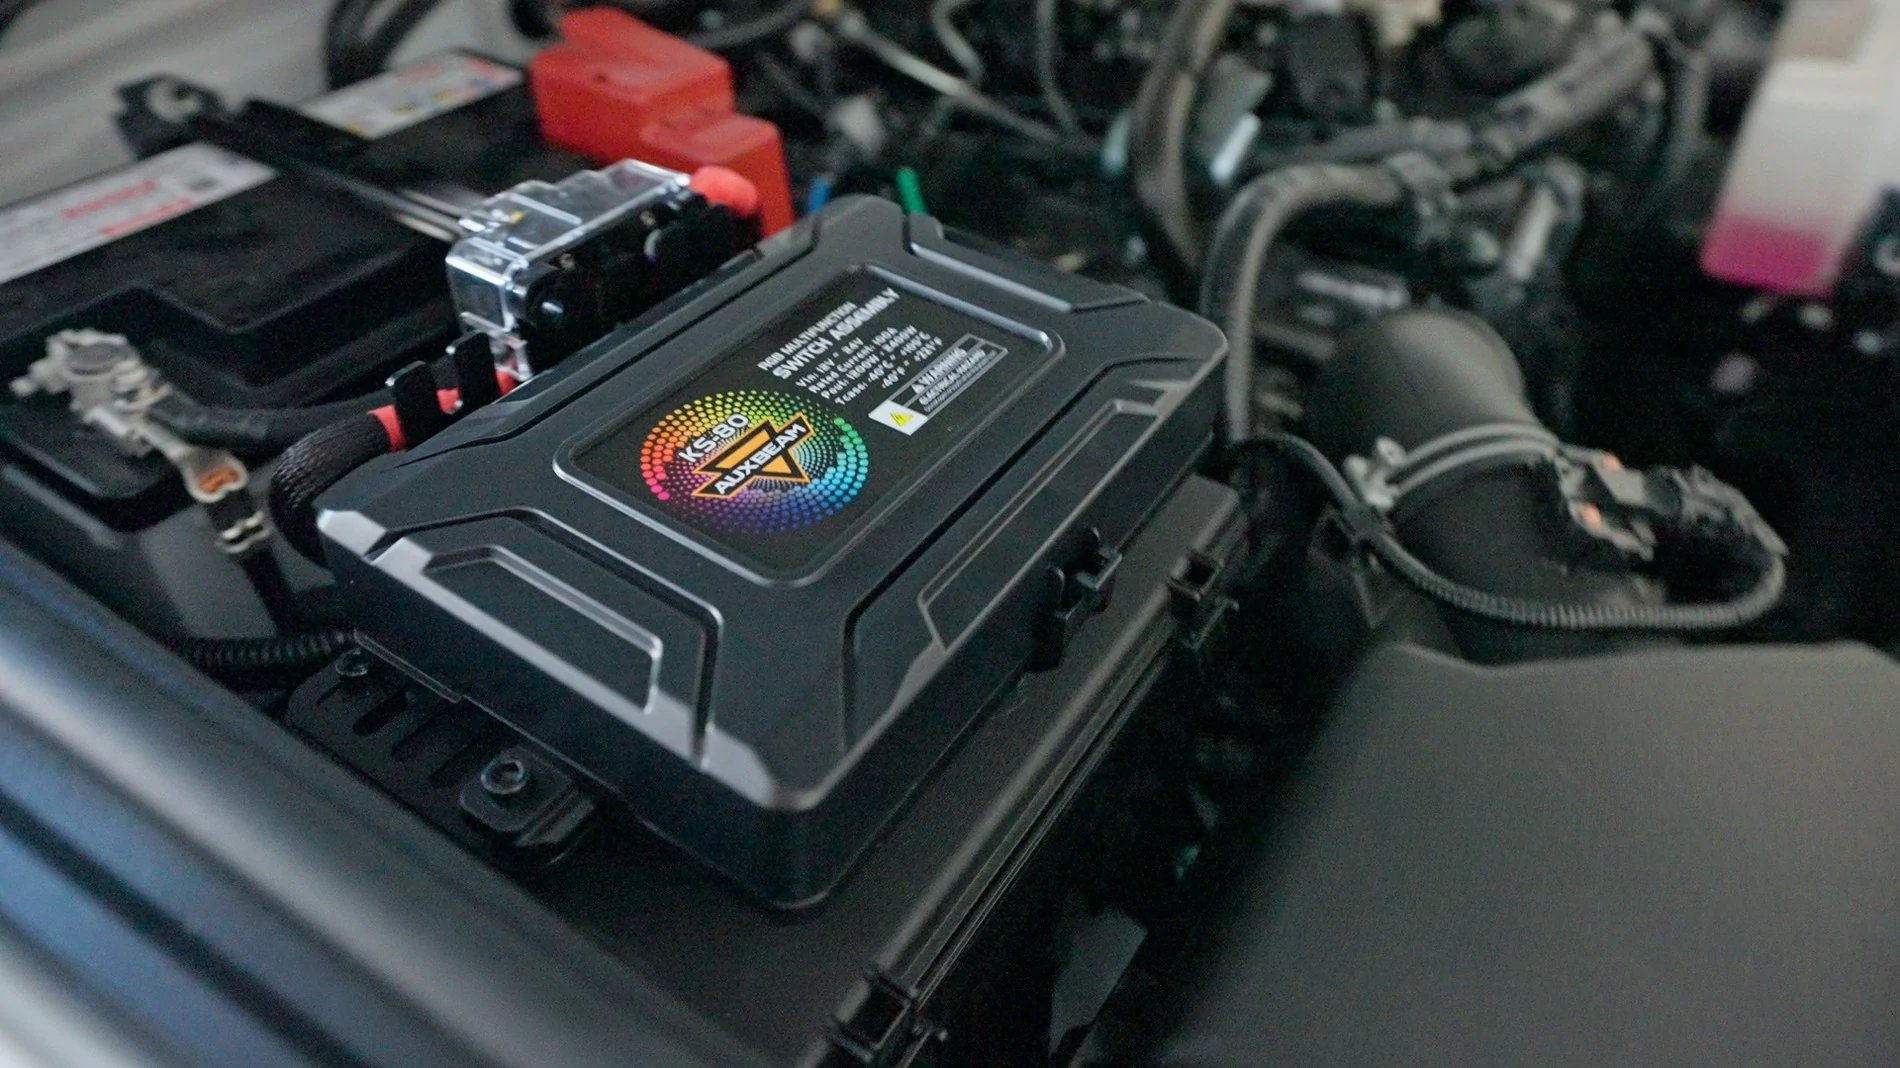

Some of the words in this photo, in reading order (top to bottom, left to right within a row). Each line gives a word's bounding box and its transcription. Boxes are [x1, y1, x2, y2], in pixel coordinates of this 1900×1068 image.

[757, 352, 786, 371] RGB
[779, 301, 858, 356] MULTIFUNCTION
[772, 336, 834, 380] SWITCH
[828, 286, 900, 341] ASSEMBLY
[808, 370, 840, 394] Rated
[836, 344, 876, 373] Current:
[871, 326, 899, 347] 100A
[820, 377, 850, 400] Pout:
[846, 353, 880, 381] 1200W
[881, 324, 918, 353] 2400W
[841, 336, 864, 354] 24V
[917, 347, 968, 386] WARNING
[678, 413, 749, 463] KS-80
[714, 423, 807, 495] AUXBEAM
